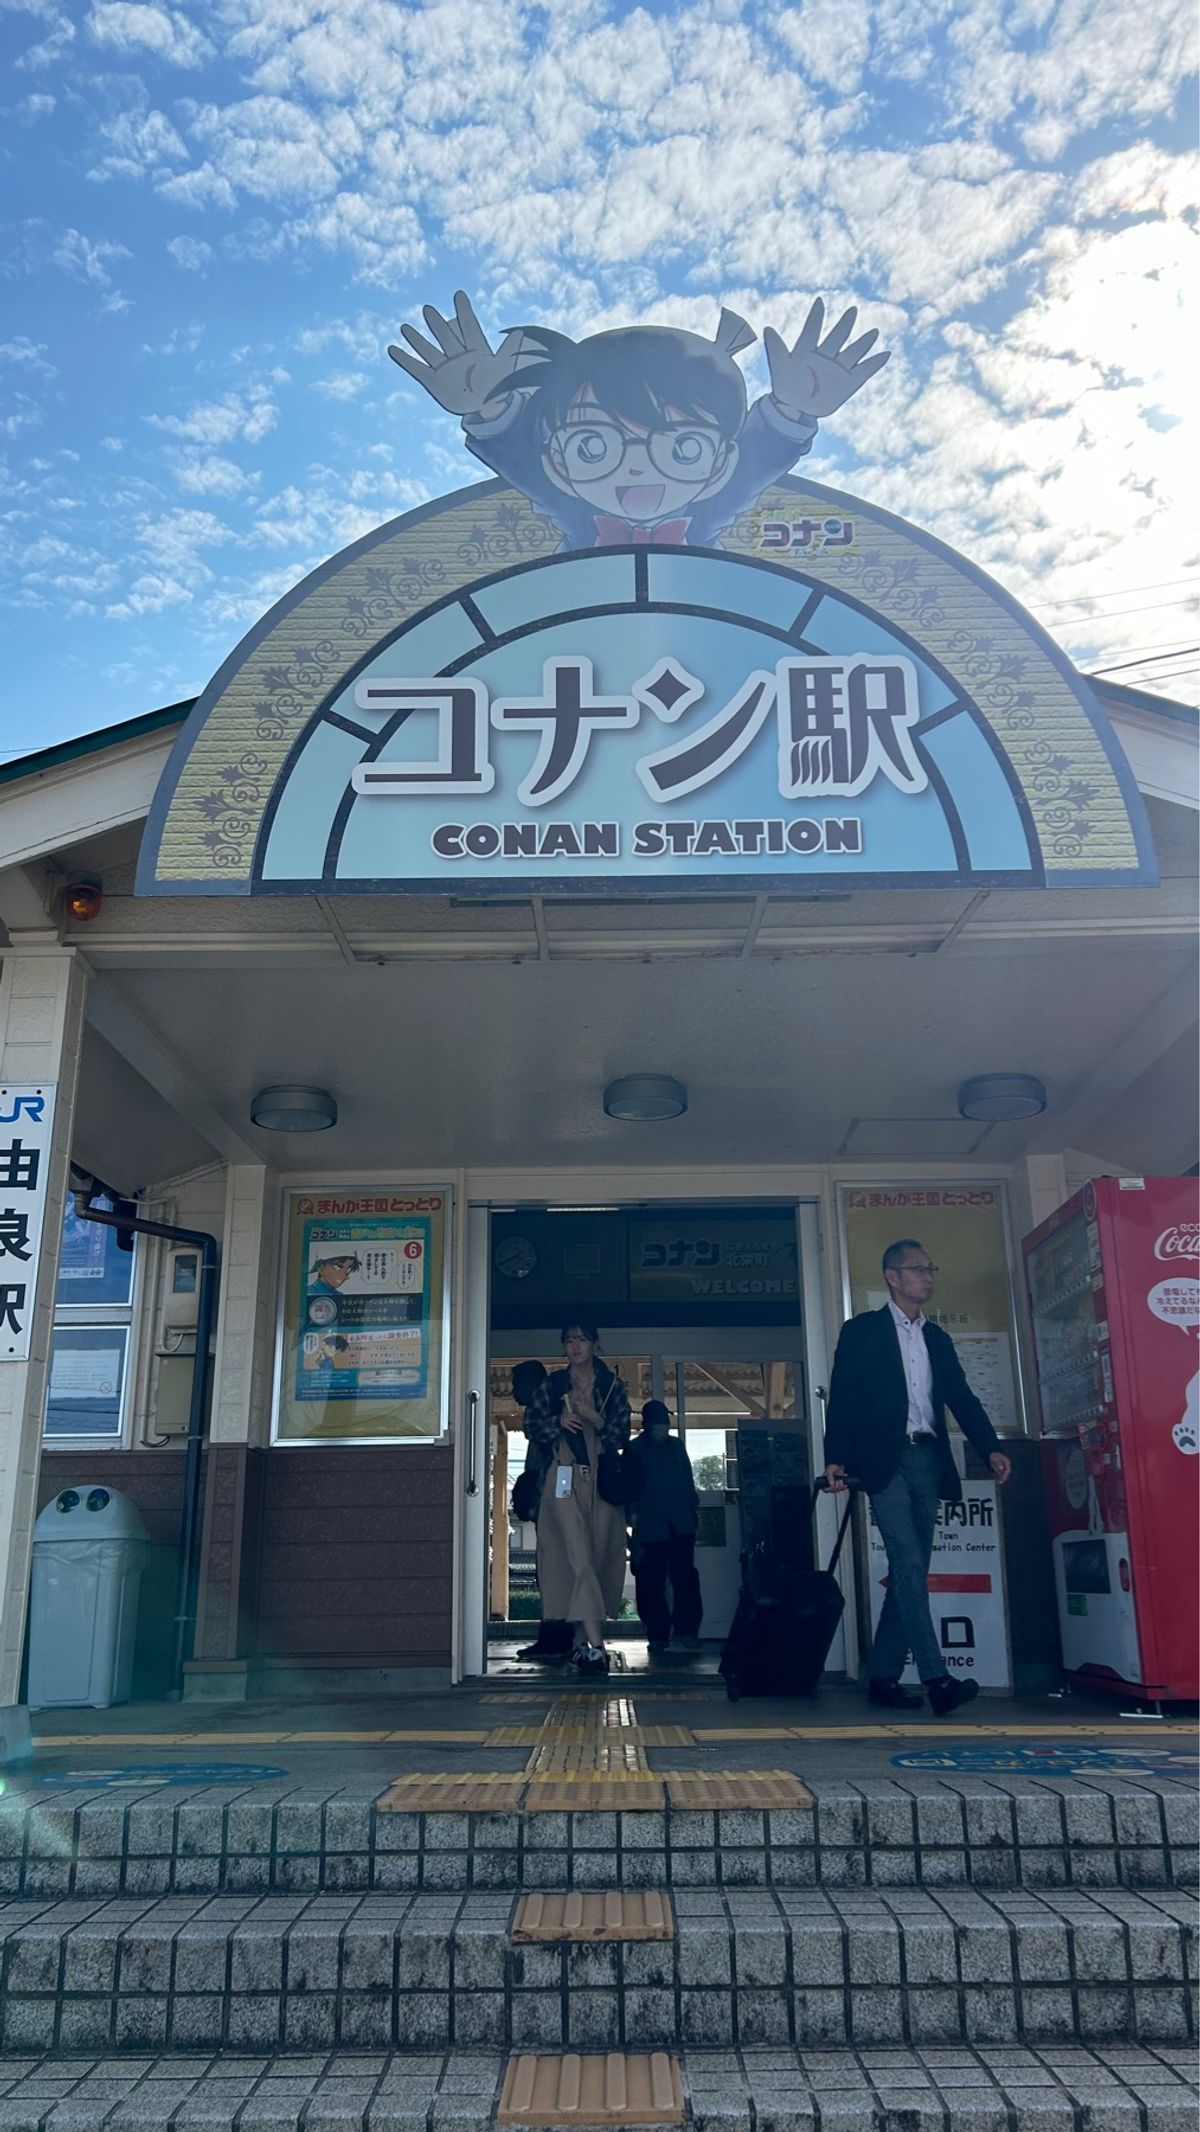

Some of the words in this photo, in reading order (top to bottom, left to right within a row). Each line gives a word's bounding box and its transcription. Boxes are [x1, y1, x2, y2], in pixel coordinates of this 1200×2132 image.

[760, 518, 854, 548] コナン
[353, 654, 928, 806] コナン駅
[431, 822, 619, 858] CONAN
[633, 818, 862, 856] STATION
[408, 1243, 418, 1257] 6
[639, 1239, 721, 1268] コナン
[691, 1278, 795, 1295] WELCOME
[966, 1543, 996, 1552] Center
